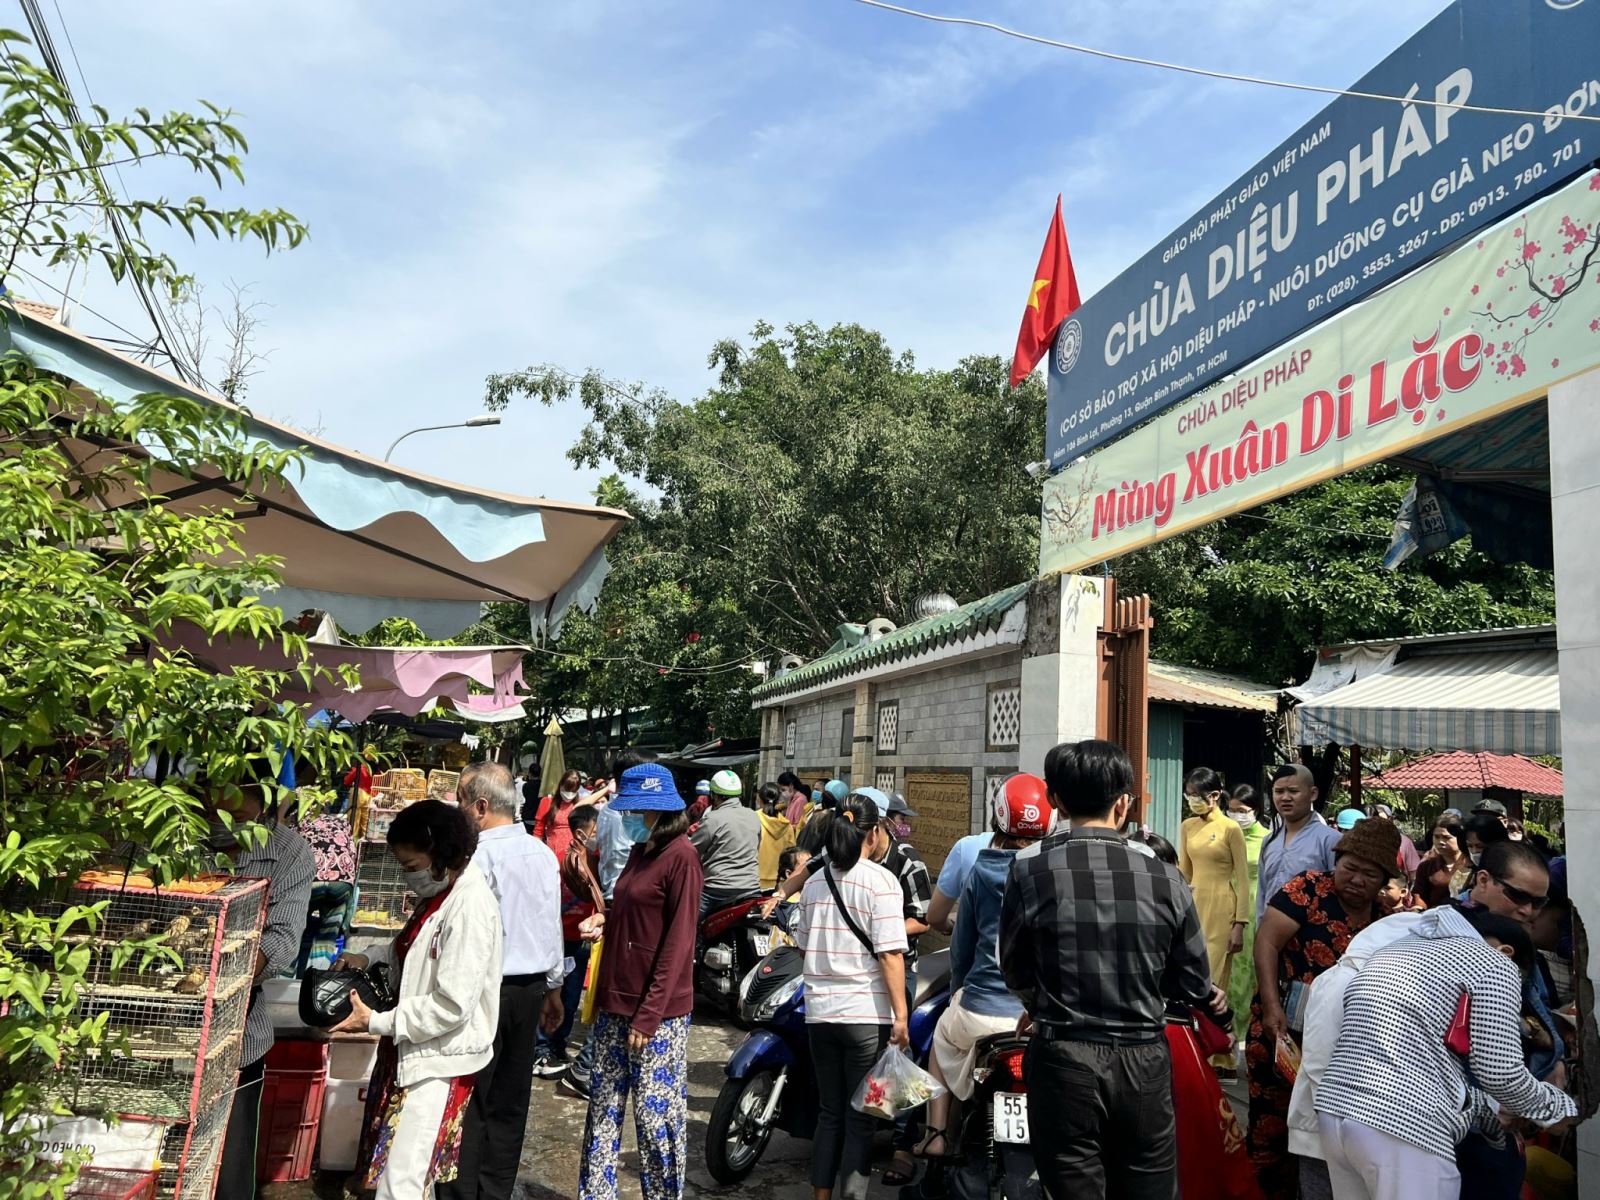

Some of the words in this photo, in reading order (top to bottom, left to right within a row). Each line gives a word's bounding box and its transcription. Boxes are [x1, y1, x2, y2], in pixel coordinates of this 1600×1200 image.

[1079, 401, 1092, 422] SỞ
[1095, 388, 1115, 415] BẢO
[1118, 372, 1138, 396] TRỢ
[1141, 359, 1157, 386] XÃ
[1160, 345, 1182, 373] HỘI
[1186, 326, 1214, 355] DIỆU
[1218, 300, 1256, 338] PHÁP
[1269, 264, 1310, 306] NUÔI
[1315, 218, 1386, 278] DƯỠNG
[1392, 191, 1424, 227] CỤ
[1430, 158, 1474, 203] GIÀ
[1482, 122, 1534, 174] NEO
[1104, 272, 1196, 366] CHÙA
[1208, 190, 1298, 300] DIỆU
[1317, 68, 1473, 226] PHÁP
[1163, 237, 1187, 263] GIÁO
[1190, 220, 1208, 244] HỘI
[1210, 196, 1237, 228] PHẬT
[1239, 172, 1268, 204] GIÁO
[1272, 148, 1297, 177] VIỆT
[1300, 122, 1330, 157] NAM
[1308, 296, 1324, 312] ĐT:
[1326, 275, 1358, 302] (028).
[1362, 252, 1394, 279] 3553.
[1398, 230, 1428, 258] 3267
[1440, 212, 1464, 234] DĐ:
[1468, 186, 1510, 216] 0913.
[1514, 162, 1548, 190] 780.
[1553, 138, 1580, 168] 701
[1091, 470, 1176, 541] Mừng
[1182, 419, 1290, 504] Xuân
[1300, 373, 1354, 456] Di
[1366, 320, 1484, 426] Lặc
[1124, 407, 1134, 419] 13,
[1196, 364, 1206, 376] TP.
[1208, 350, 1228, 370] HCM
[1178, 399, 1216, 435] CHÙA
[1222, 377, 1258, 410] DIỆU
[1264, 348, 1312, 394] PHÁP
